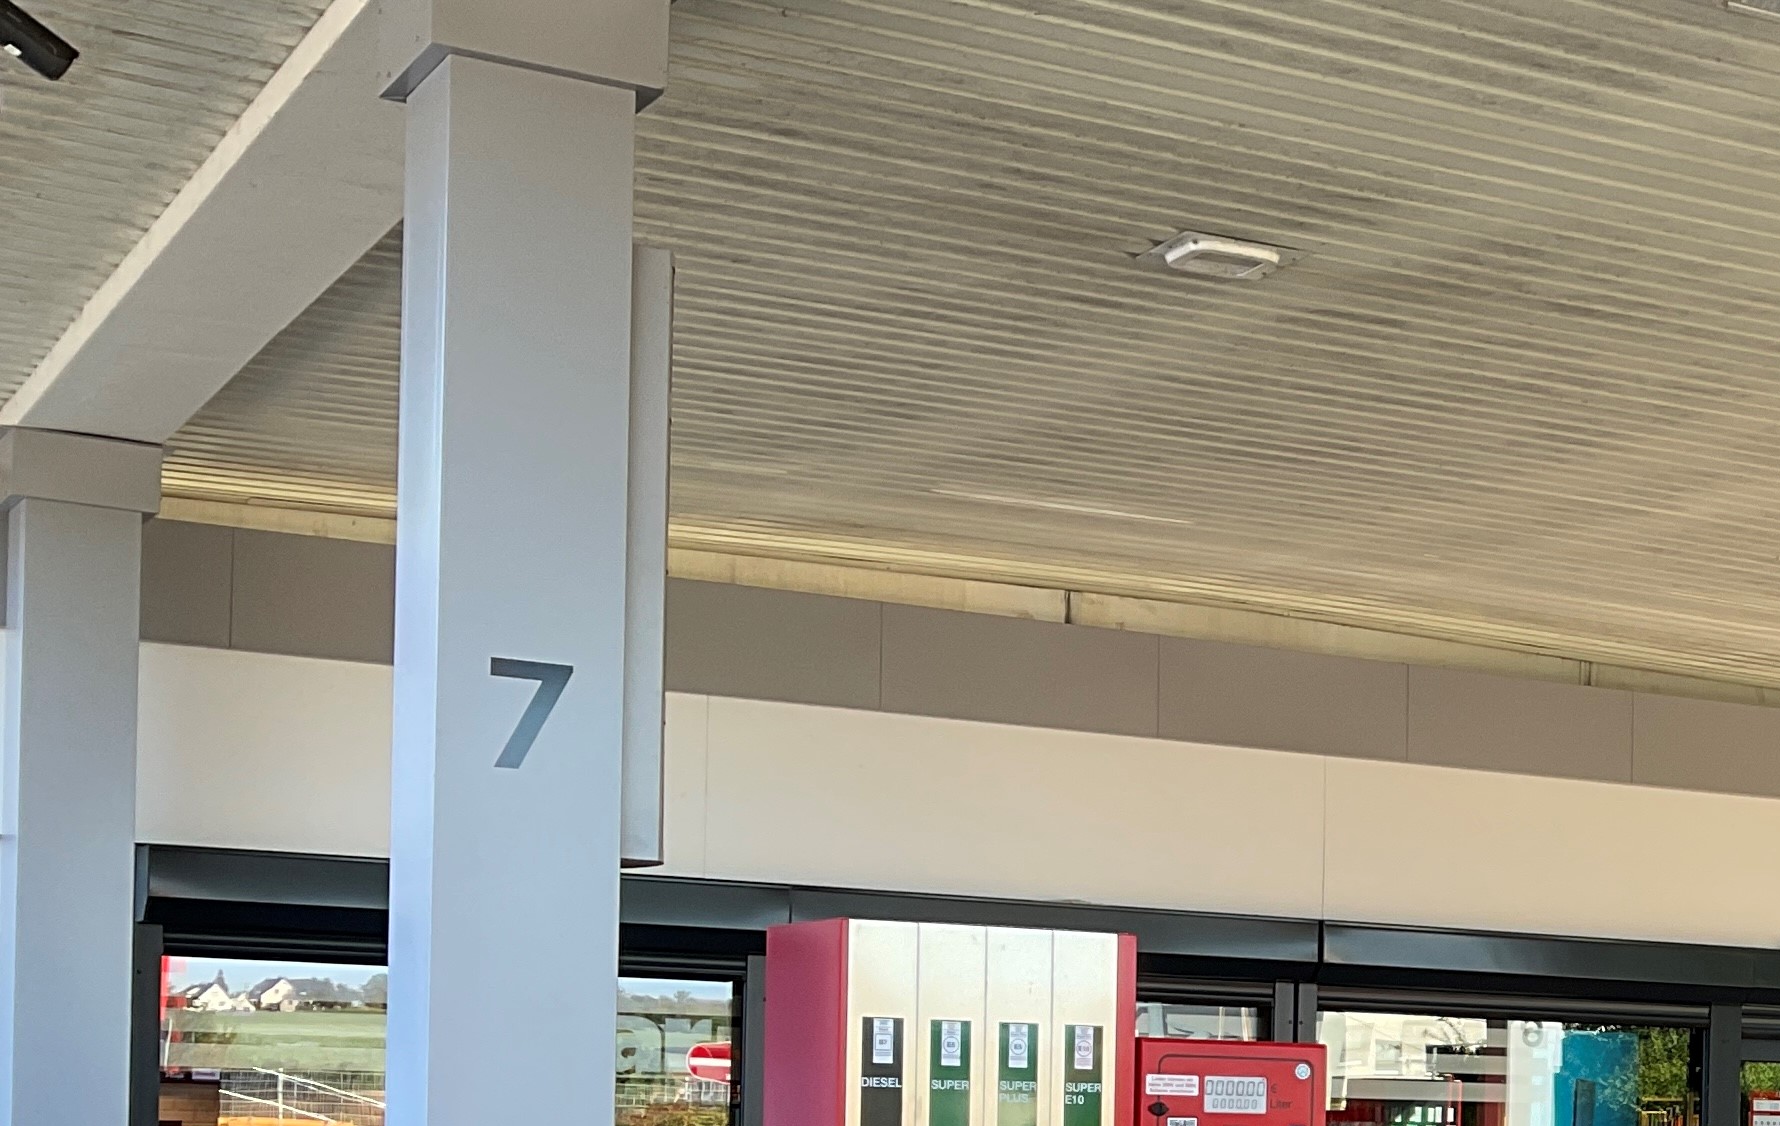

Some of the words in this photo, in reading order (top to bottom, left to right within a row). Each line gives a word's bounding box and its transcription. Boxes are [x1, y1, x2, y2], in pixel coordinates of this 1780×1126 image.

[490, 657, 574, 769] 7
[861, 1076, 902, 1089] DIESEL
[931, 1079, 970, 1091] SUPER
[999, 1080, 1037, 1092] SUPER
[1065, 1082, 1102, 1093] SUPER
[1065, 1094, 1085, 1105] E10
